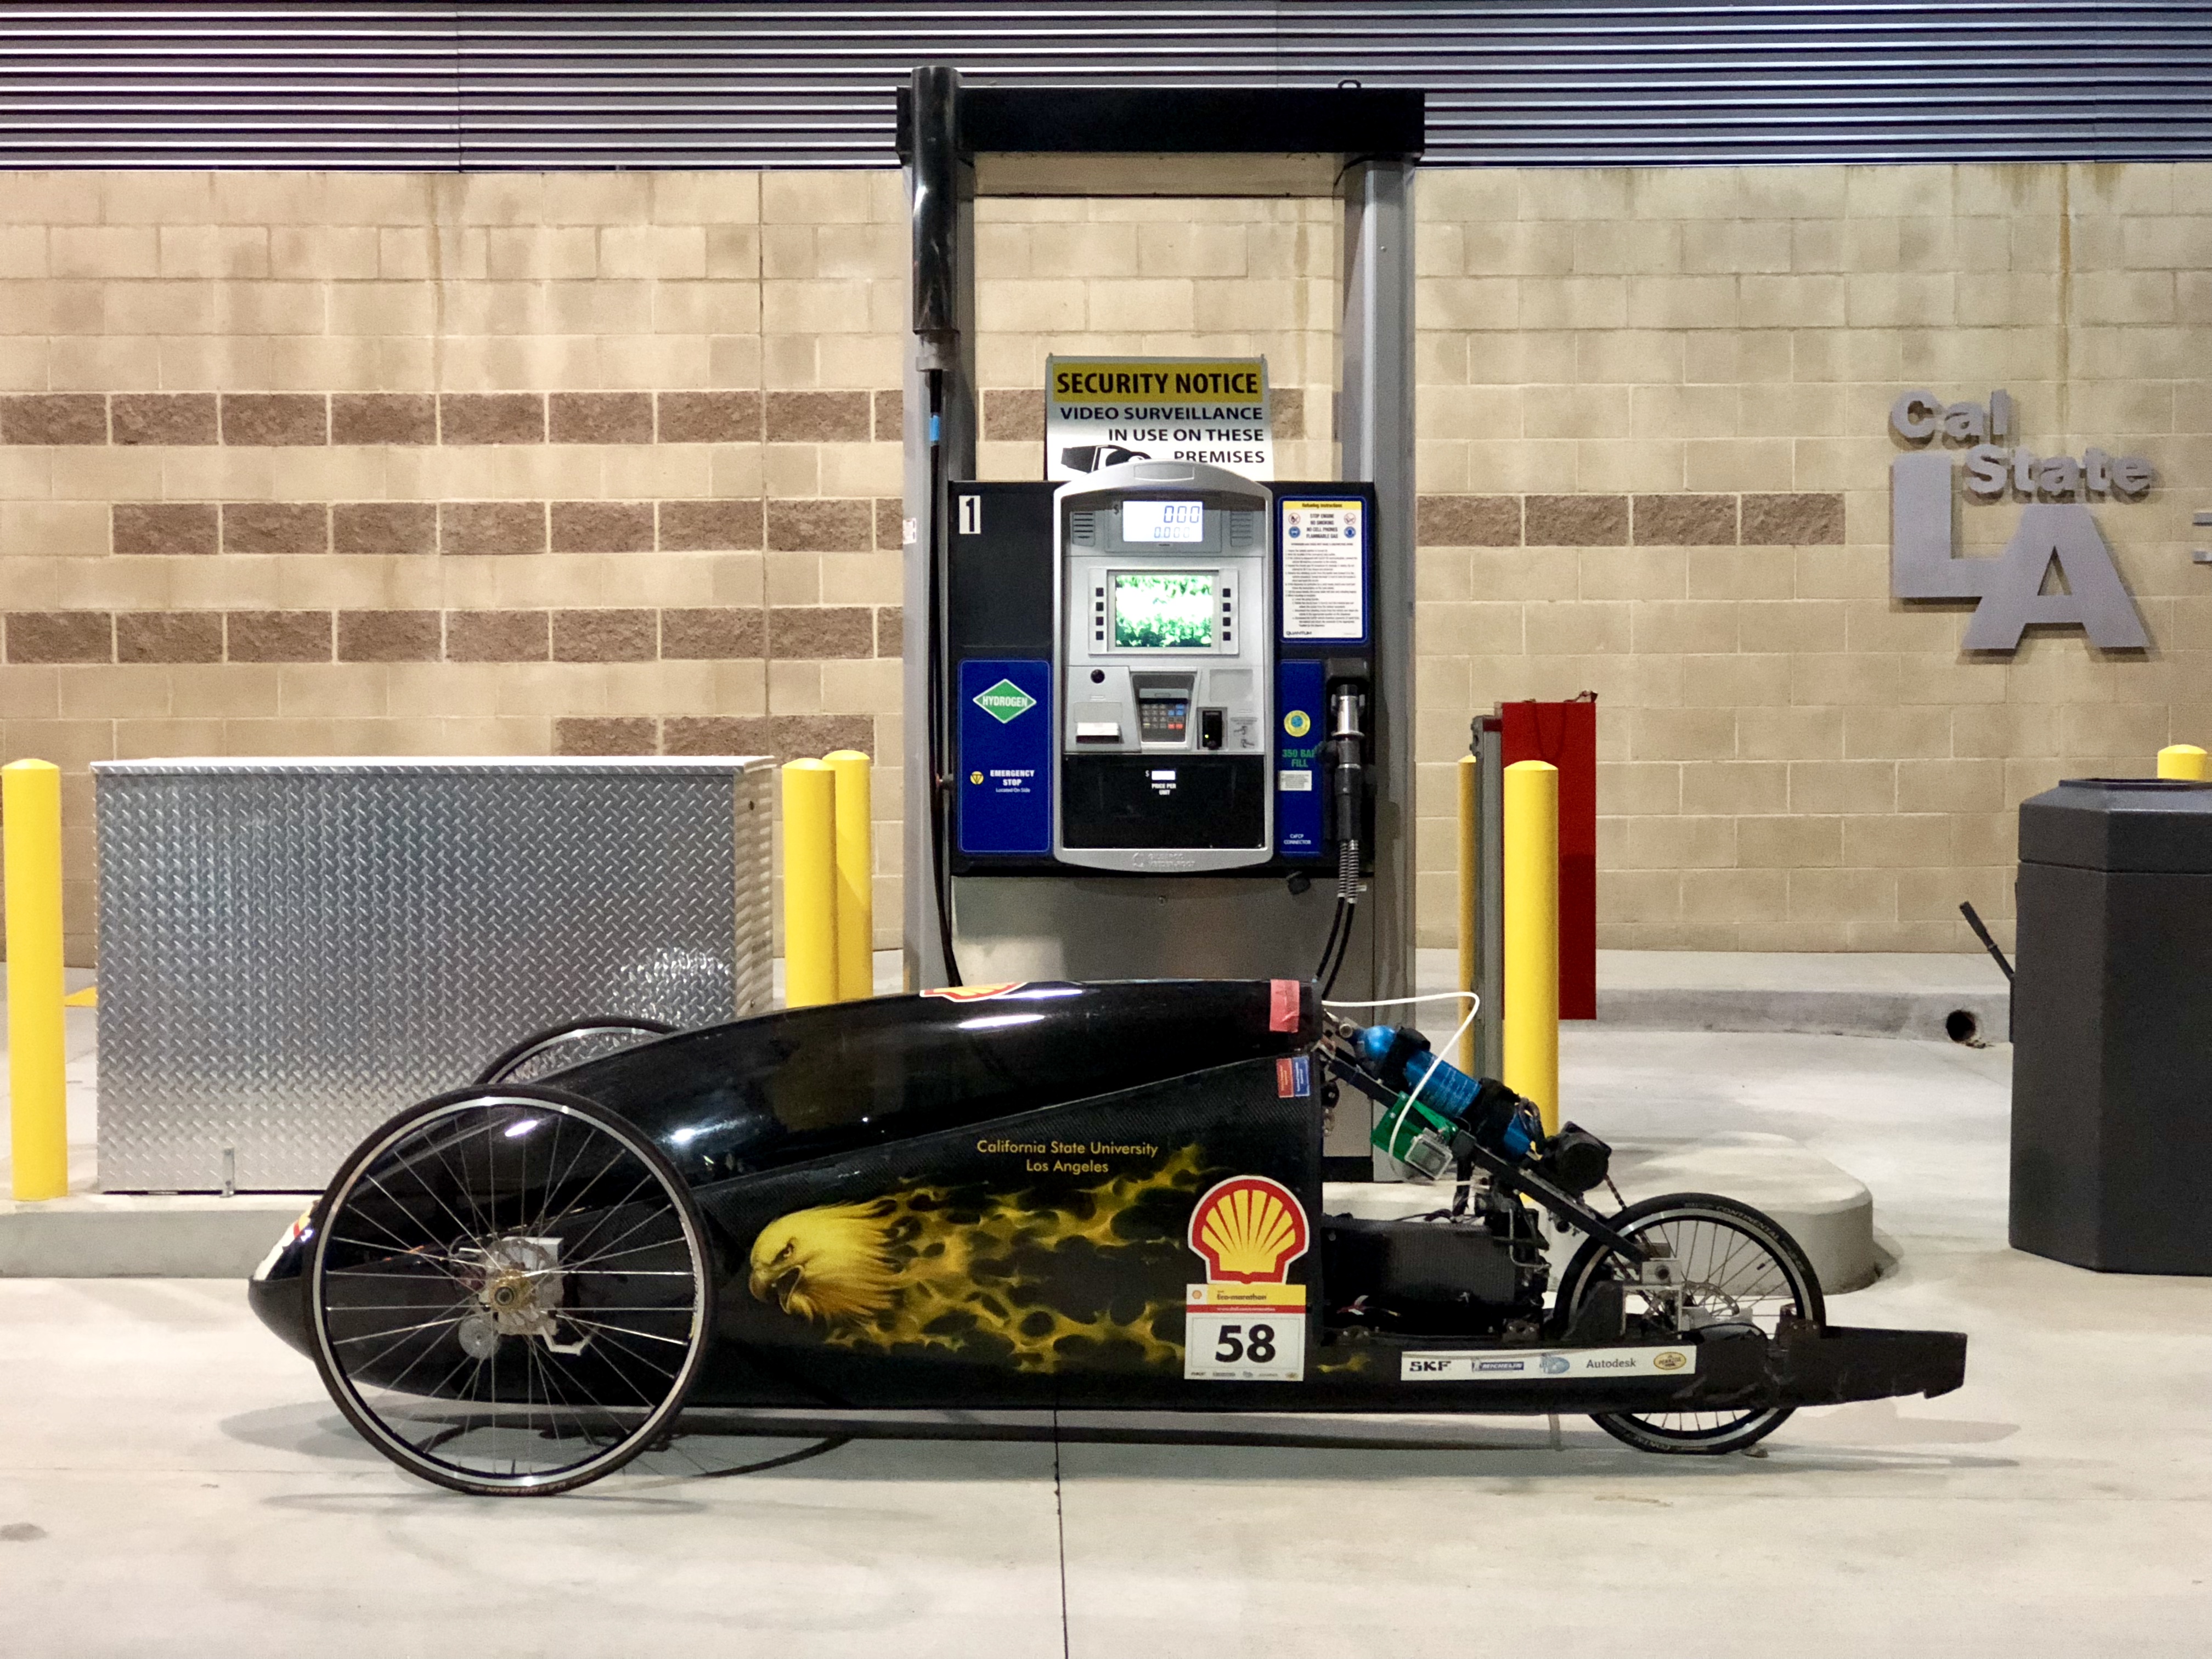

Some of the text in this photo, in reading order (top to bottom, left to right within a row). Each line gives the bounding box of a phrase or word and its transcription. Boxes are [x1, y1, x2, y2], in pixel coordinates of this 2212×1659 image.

[1057, 373, 1258, 394] SECURITY NOTICE
[1060, 407, 1263, 420] VIDEO SURVEILLANCE
[1892, 390, 2008, 439] Cal
[1108, 428, 1265, 442] IN USE ON THESE
[1174, 450, 1265, 463] PREMISES
[1966, 444, 2153, 495] State
[966, 498, 974, 532] 1
[1893, 453, 2148, 650] LA
[983, 696, 1028, 707] HYDROGEN
[1291, 759, 1309, 768] FILL
[977, 1139, 1159, 1159] California State University
[1026, 1159, 1109, 1175] Los Angeles
[1215, 1324, 1276, 1363] 58
[1409, 1361, 1452, 1372] SKF
[1586, 1358, 1637, 1369] Autodesk
